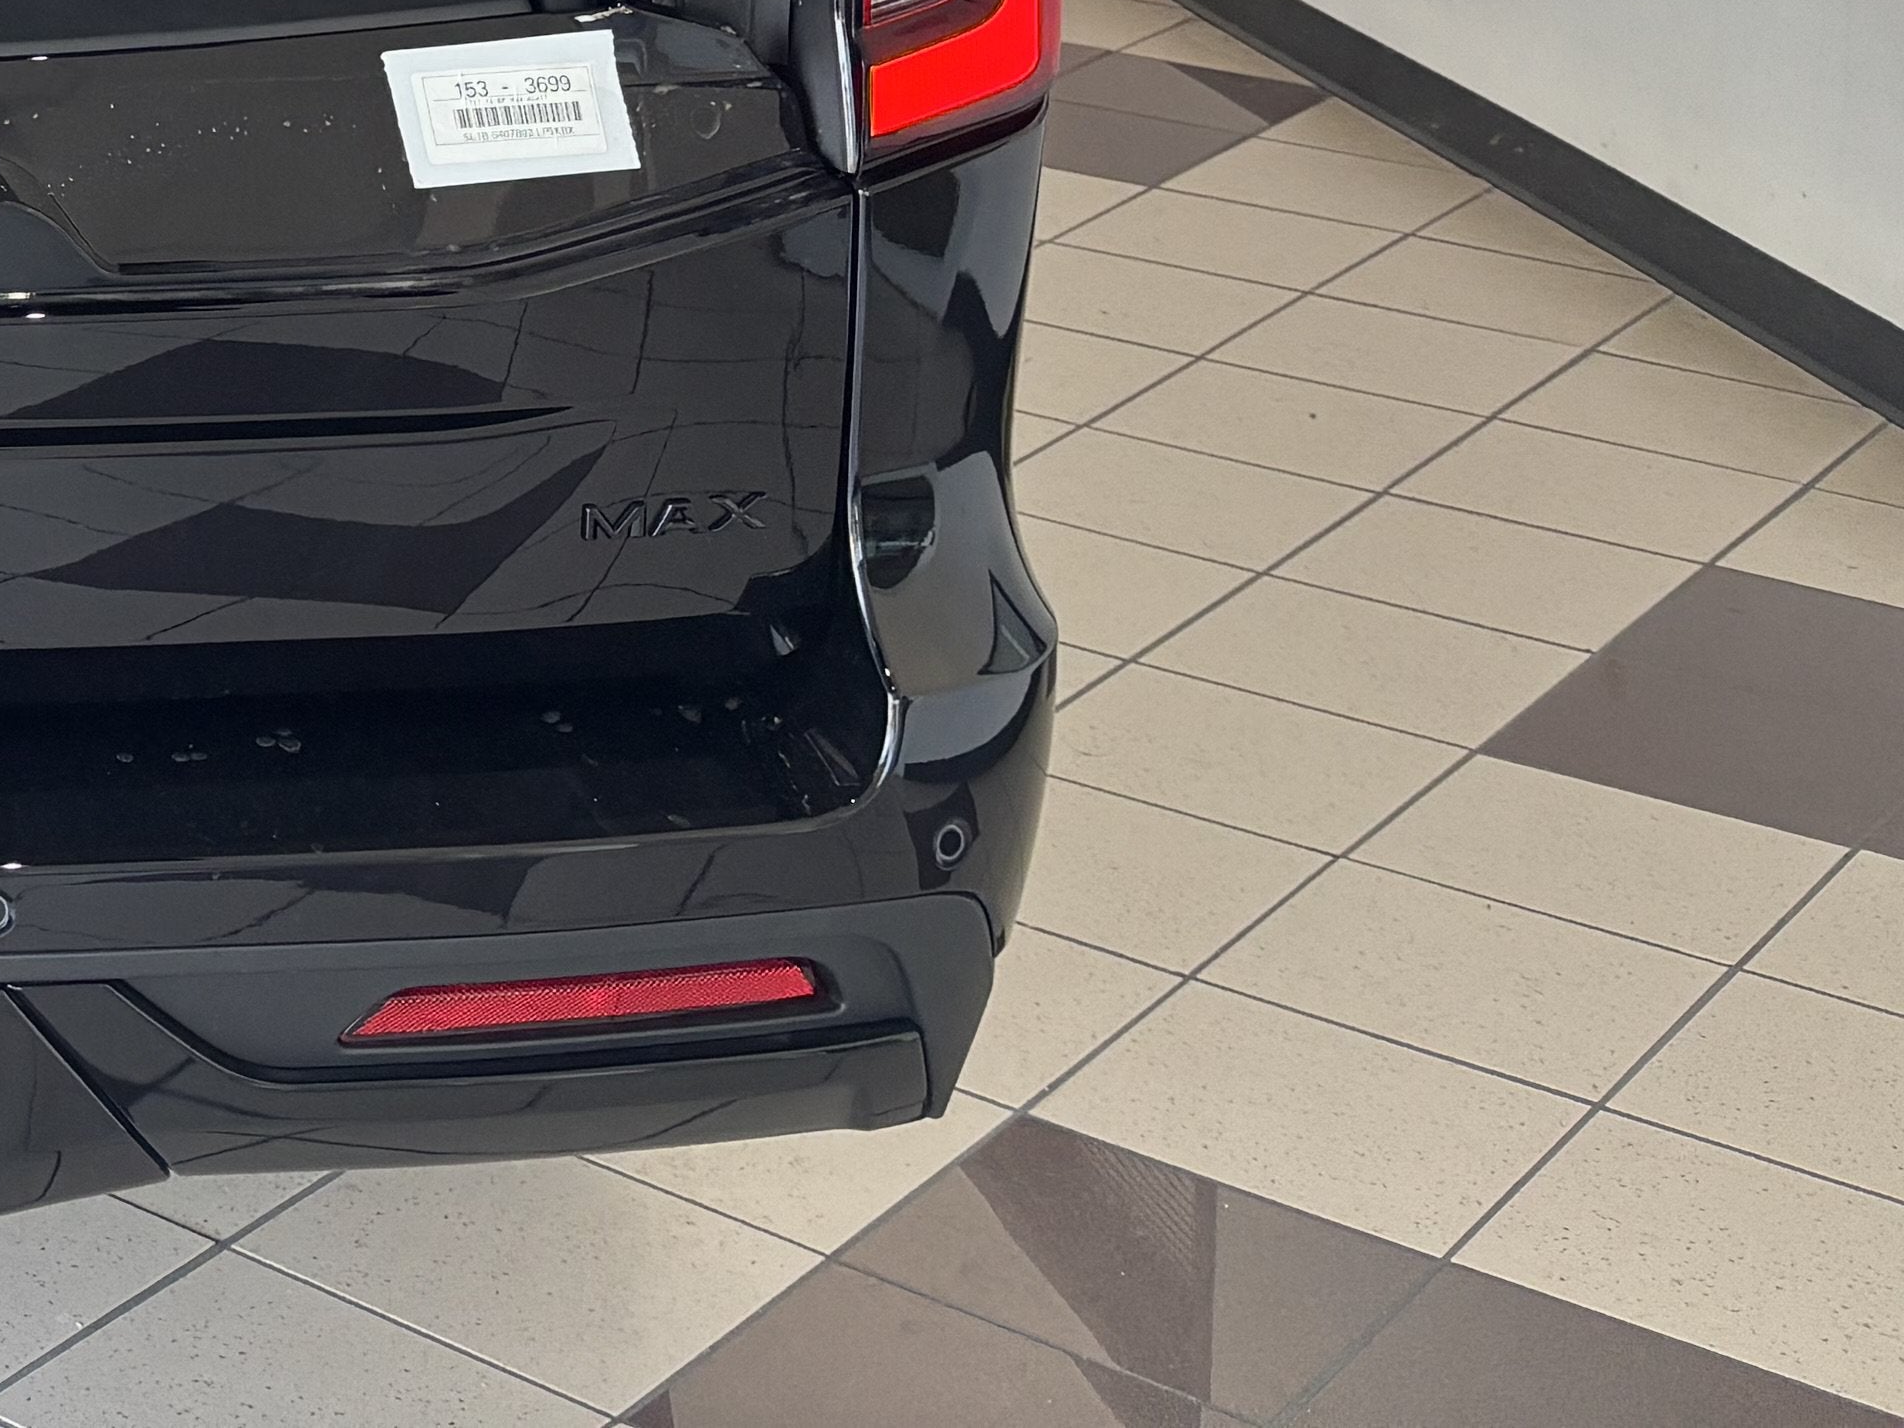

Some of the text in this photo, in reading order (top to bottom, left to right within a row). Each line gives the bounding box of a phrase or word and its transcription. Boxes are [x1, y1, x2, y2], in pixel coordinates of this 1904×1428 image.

[454, 80, 489, 99] 153
[524, 74, 572, 94] 3699
[580, 491, 767, 541] MAX
